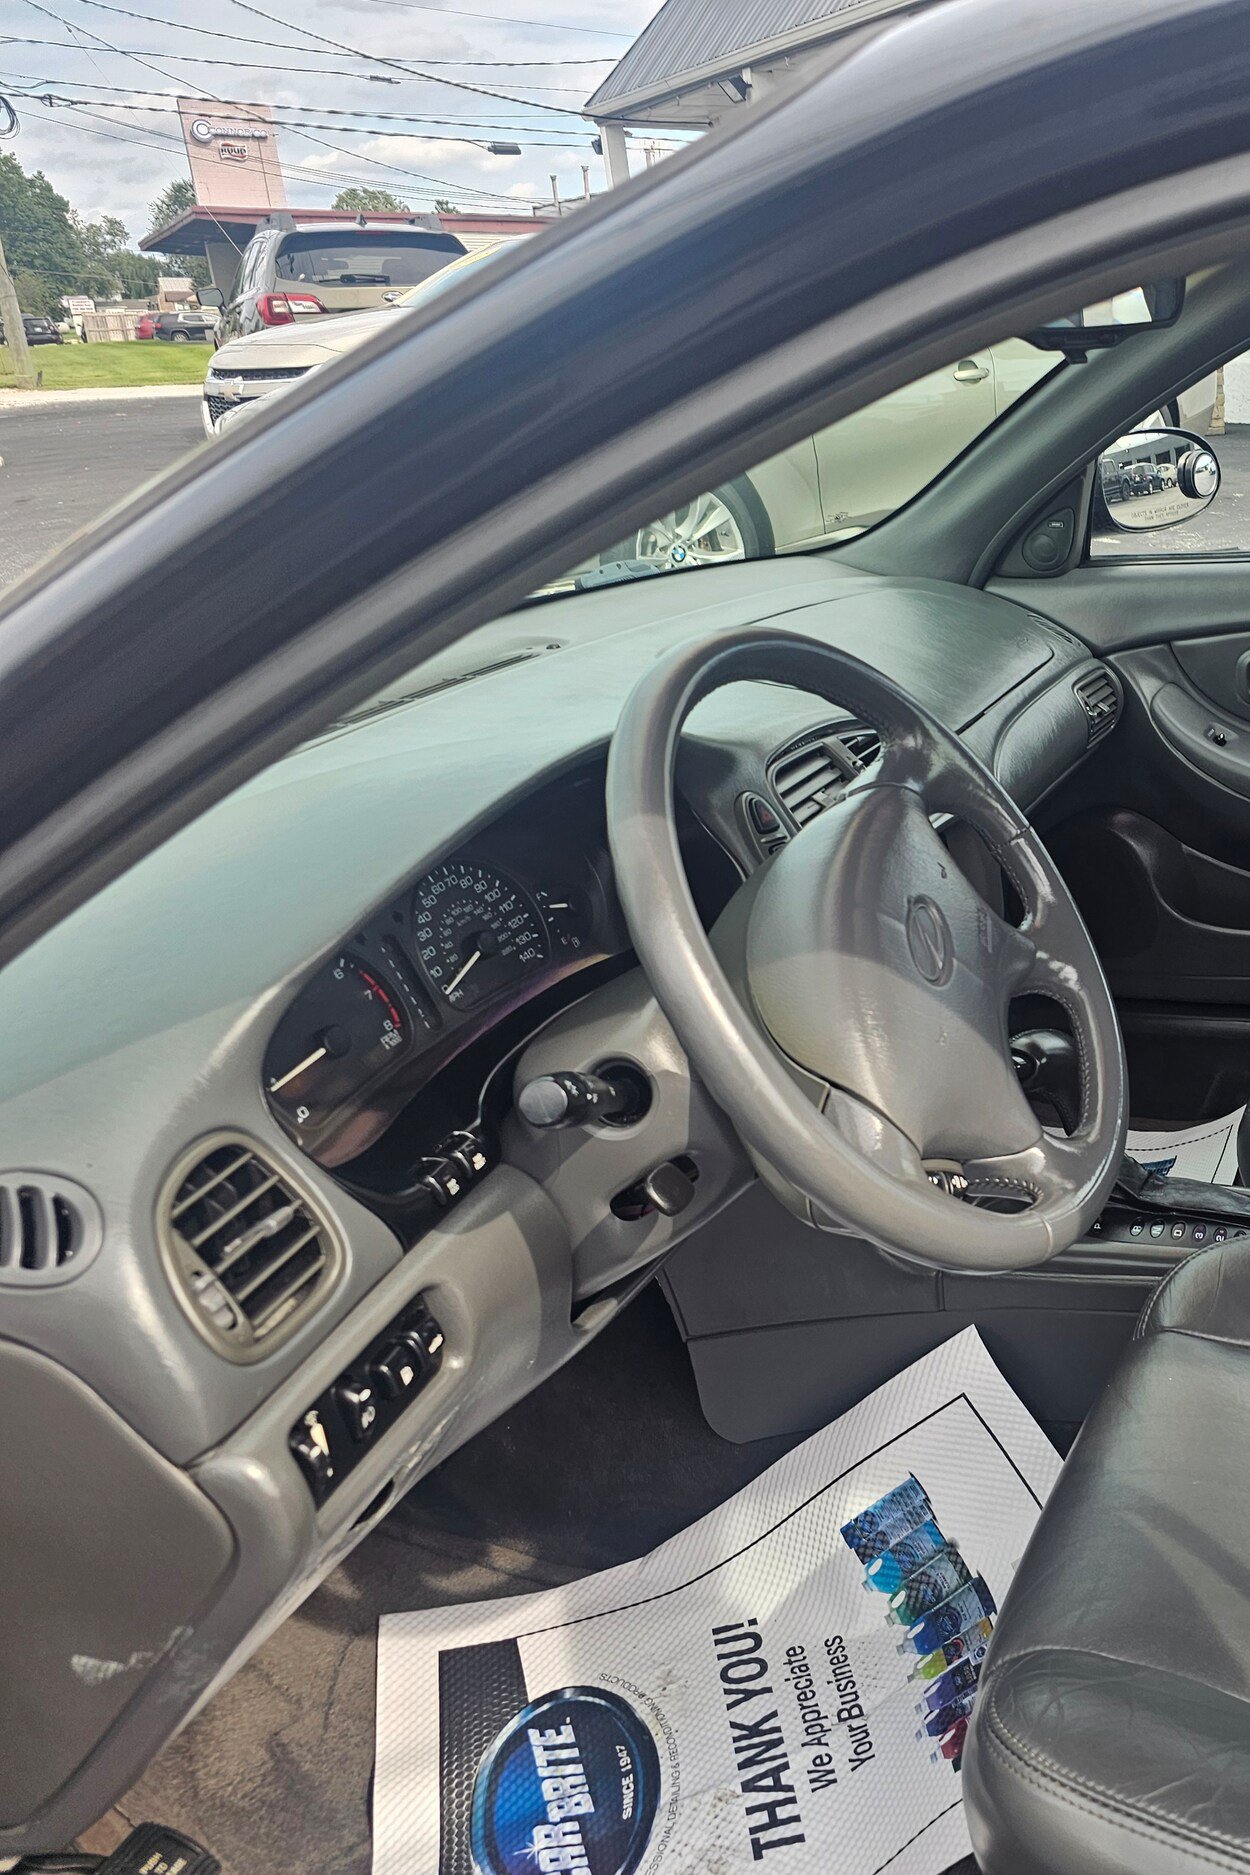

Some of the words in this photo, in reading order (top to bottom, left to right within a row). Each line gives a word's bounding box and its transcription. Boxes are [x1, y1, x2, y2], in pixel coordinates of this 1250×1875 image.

[431, 881, 446, 895] 60
[444, 875, 459, 887] 70
[459, 875, 474, 889] 80
[474, 880, 488, 893] 90
[422, 895, 437, 908] 50
[484, 888, 501, 902] 100
[499, 900, 514, 914] 110
[417, 911, 432, 924] 40
[508, 915, 524, 929] 120
[417, 927, 432, 942] 30
[516, 931, 532, 946] 130
[421, 946, 436, 960] 20
[519, 948, 536, 963] 140
[333, 968, 345, 980] 6
[430, 966, 443, 978] 10
[364, 990, 372, 1000] 7
[383, 1020, 393, 1030] 8
[711, 1617, 774, 1711] YOU!
[599, 1672, 647, 1700] PRODUCTS
[824, 1635, 865, 1723] Business
[783, 1645, 832, 1748] Appreciate
[643, 1697, 681, 1762] RECONDITIONING
[848, 1723, 876, 1772] Your
[615, 1745, 633, 1773] 1947
[527, 1724, 595, 1823] BRITE
[806, 1752, 838, 1793] We
[729, 1709, 806, 1861] THANK
[621, 1773, 635, 1820] SINCE
[667, 1770, 681, 1821] DETAILING
[644, 1822, 675, 1875] ESSIONAL
